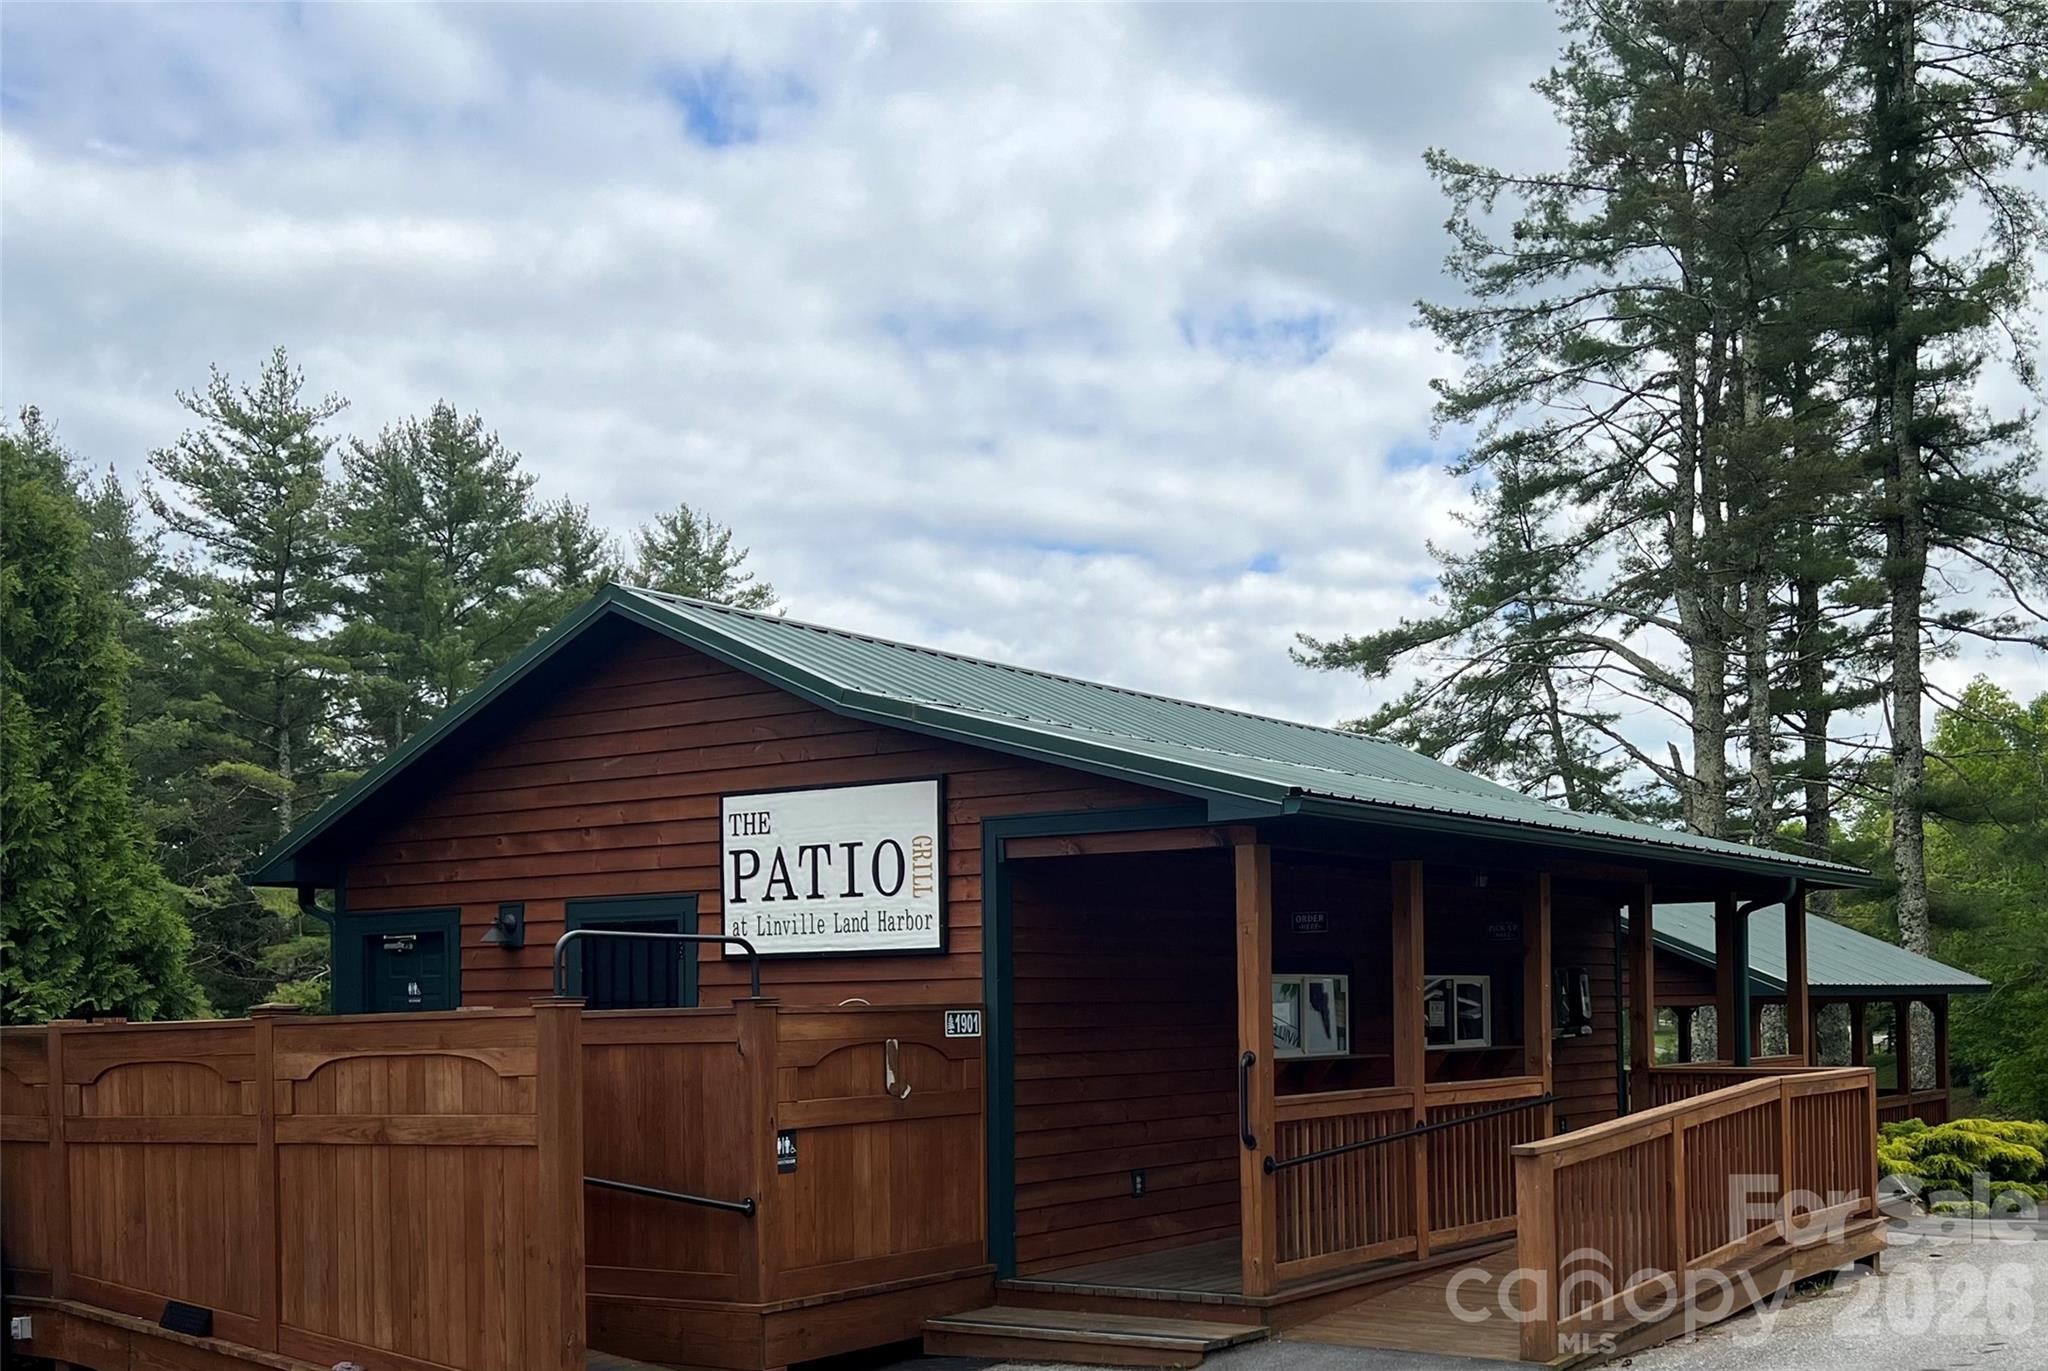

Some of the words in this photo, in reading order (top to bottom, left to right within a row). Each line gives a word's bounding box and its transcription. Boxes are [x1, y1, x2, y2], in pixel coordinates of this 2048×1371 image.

[729, 811, 771, 837] THE
[728, 839, 906, 904] PATIO
[911, 835, 934, 898] GRILL
[732, 916, 748, 938] at
[756, 913, 826, 937] Linville
[833, 910, 870, 934] Land
[877, 908, 933, 932] Harbor
[1295, 914, 1325, 923] ORDER
[954, 1013, 979, 1034] 1901
